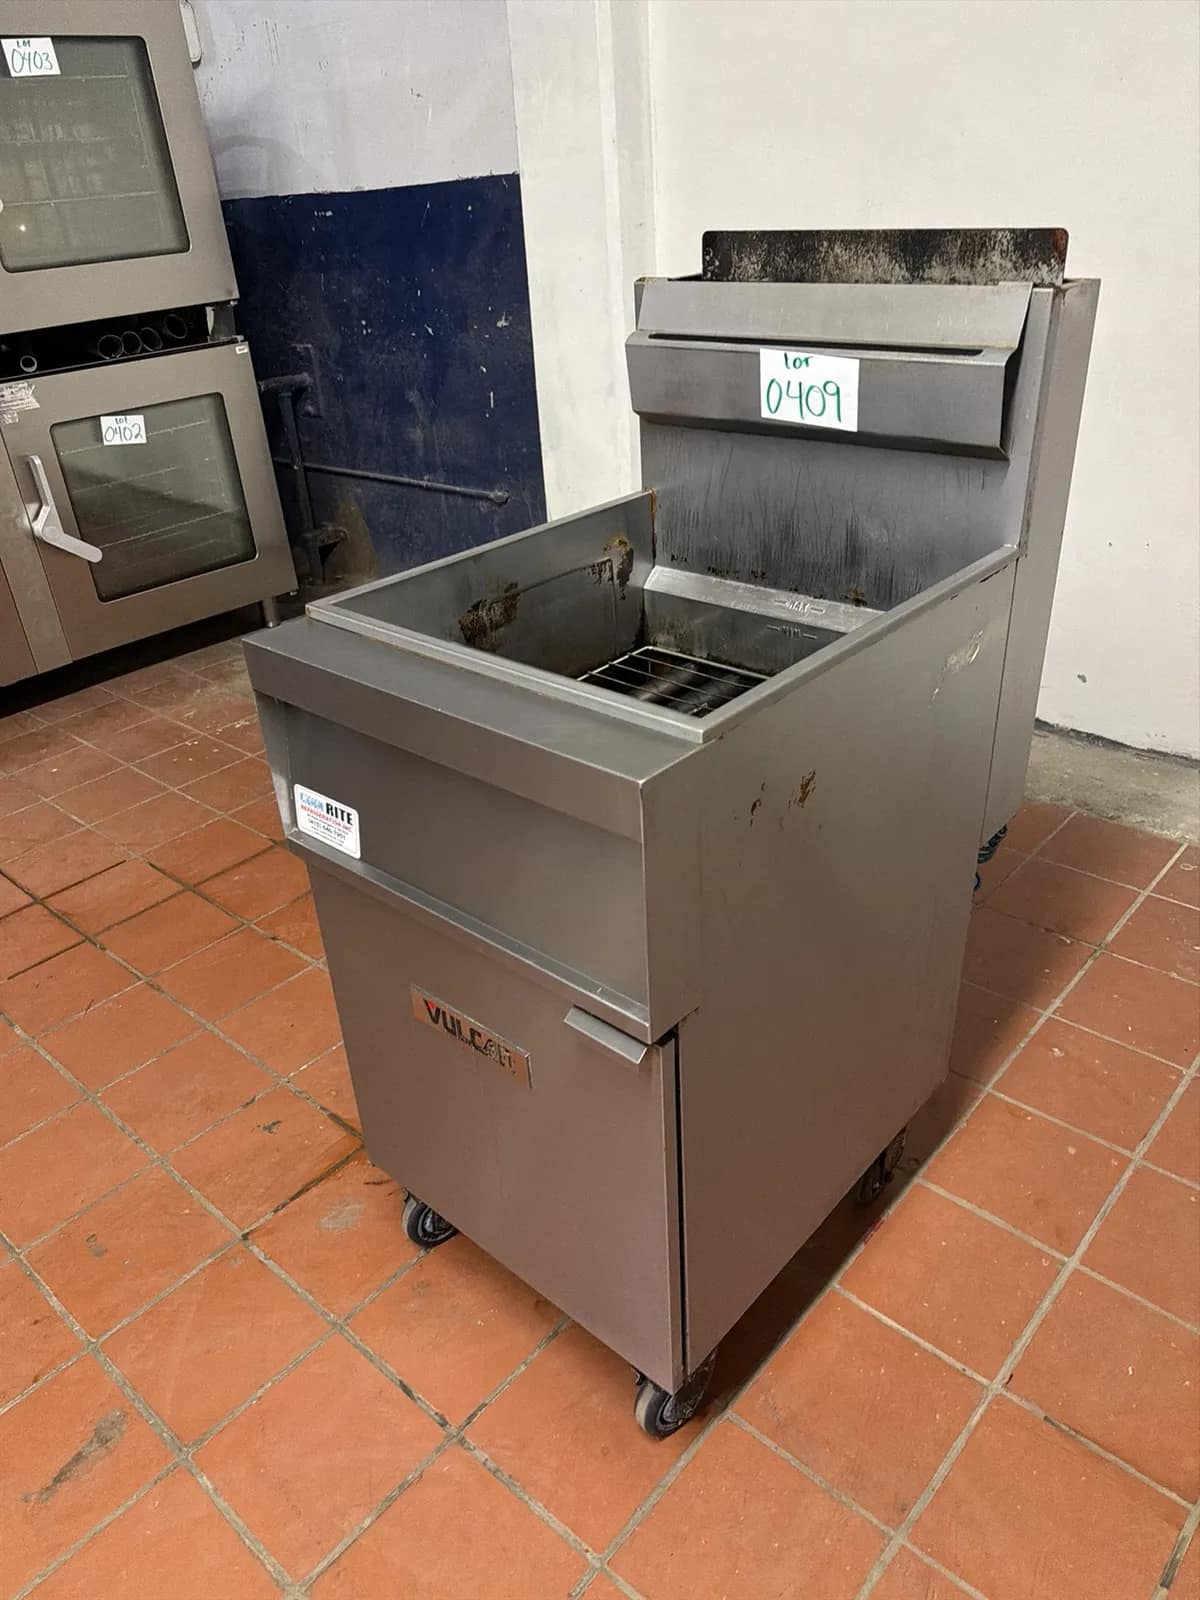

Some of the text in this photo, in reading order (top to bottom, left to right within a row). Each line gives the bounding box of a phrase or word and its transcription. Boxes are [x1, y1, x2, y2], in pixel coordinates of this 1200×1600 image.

[11, 48, 53, 74] 0403
[766, 378, 841, 423] 0409
[104, 423, 143, 442] 0402
[325, 802, 354, 826] RITE
